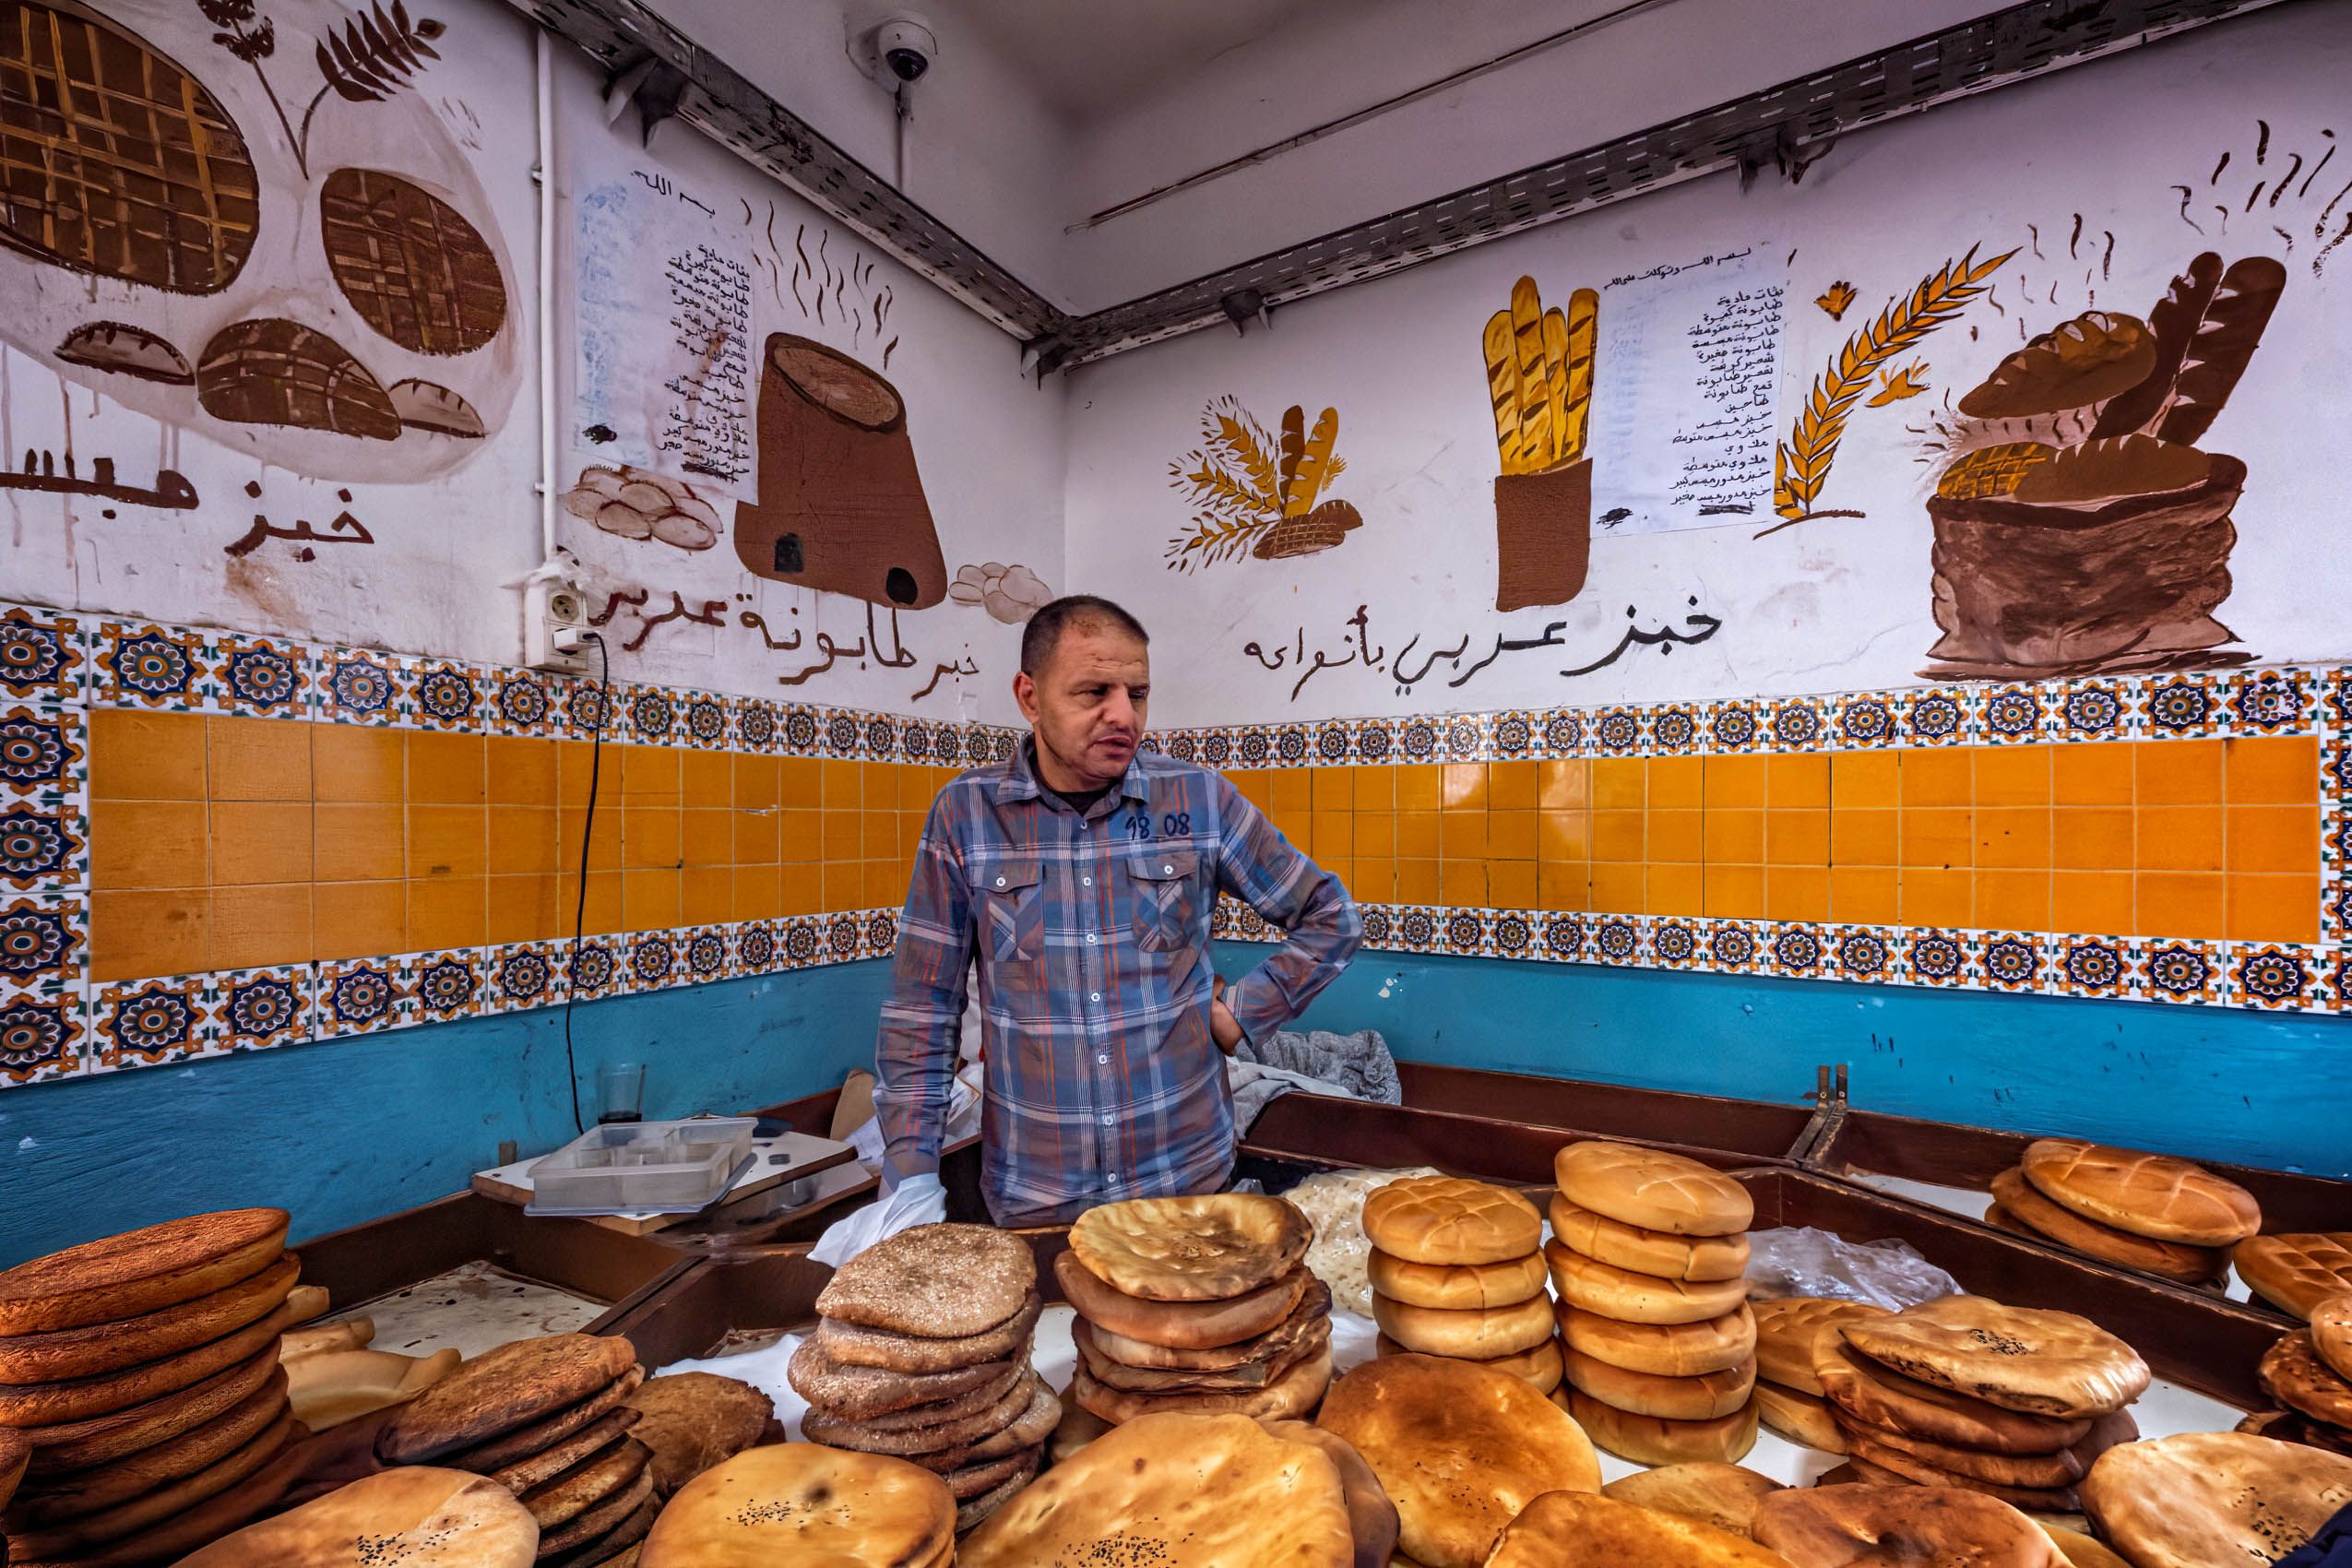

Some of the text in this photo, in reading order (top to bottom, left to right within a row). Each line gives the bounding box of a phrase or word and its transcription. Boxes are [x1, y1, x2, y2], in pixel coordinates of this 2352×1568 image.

[1741, 410, 1772, 426] خبز
[1741, 423, 1773, 438] خبز
[1743, 468, 1771, 482] خبز
[1745, 485, 1772, 499] خبز
[224, 481, 375, 564] خبز
[737, 593, 917, 685] طابونة
[1560, 596, 1723, 678] خبز
[1392, 620, 1567, 697] عربي
[1125, 812, 1190, 840] 18 08
